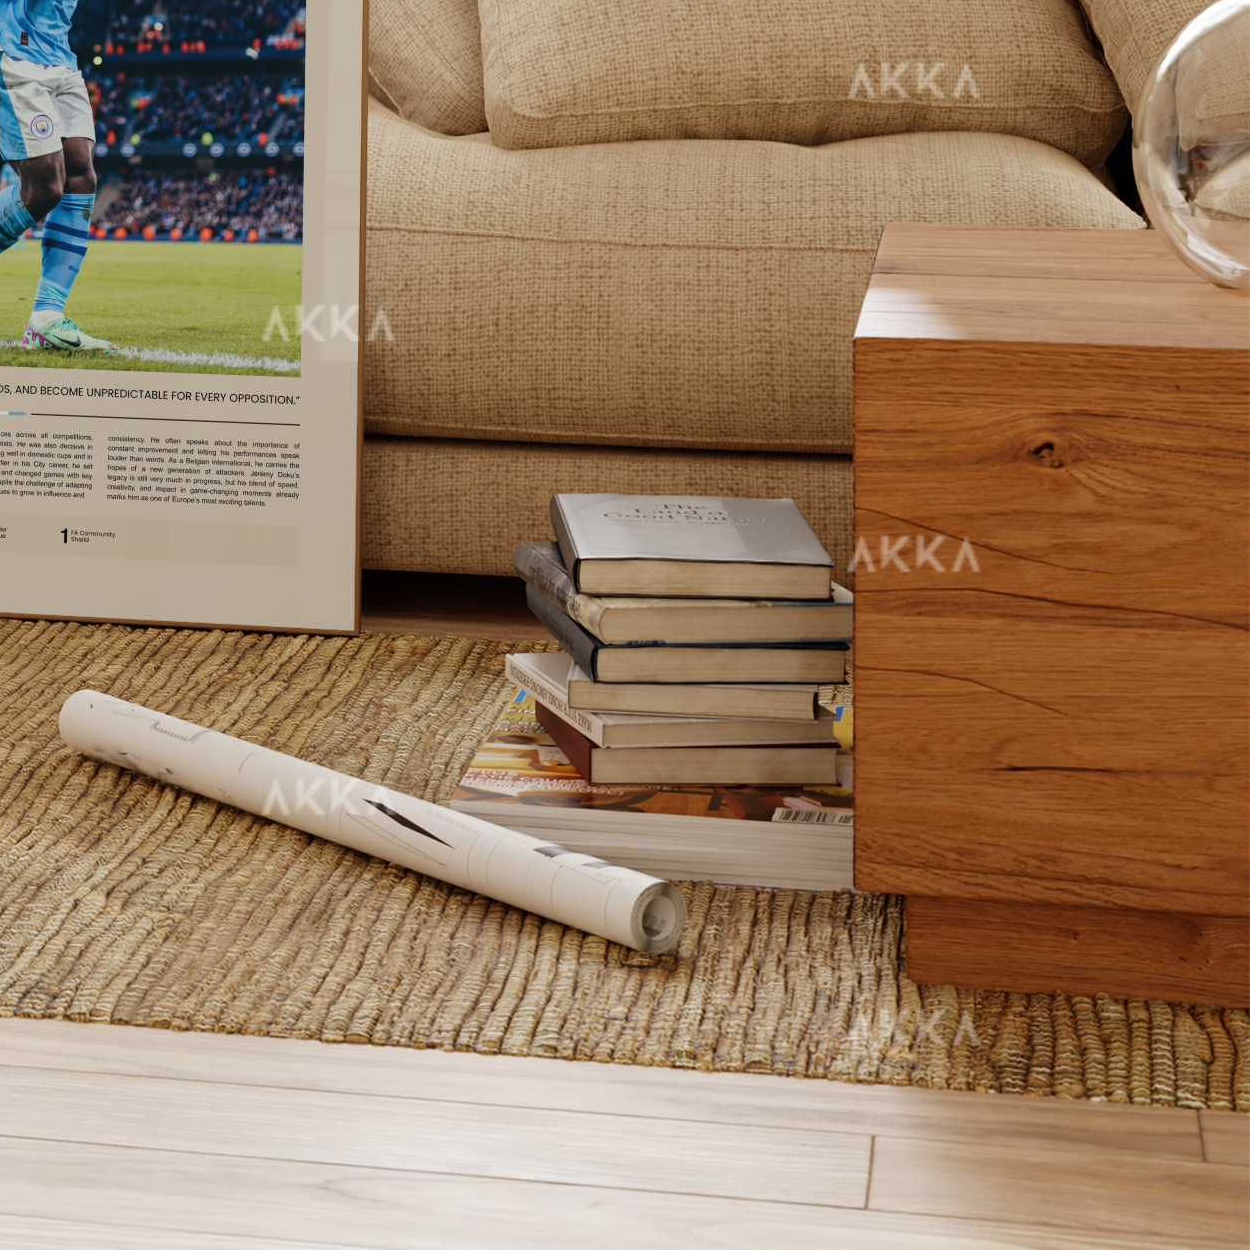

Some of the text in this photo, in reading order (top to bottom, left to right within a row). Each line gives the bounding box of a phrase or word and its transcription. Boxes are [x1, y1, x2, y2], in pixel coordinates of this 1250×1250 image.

[14, 385, 38, 394] AND
[40, 385, 83, 396] BECOME
[86, 387, 168, 400] UNPREDICTABLE
[171, 390, 192, 400] FOR
[194, 391, 226, 402] EVERY
[252, 440, 288, 448] importance
[60, 528, 68, 544] 1
[78, 530, 115, 538] Community
